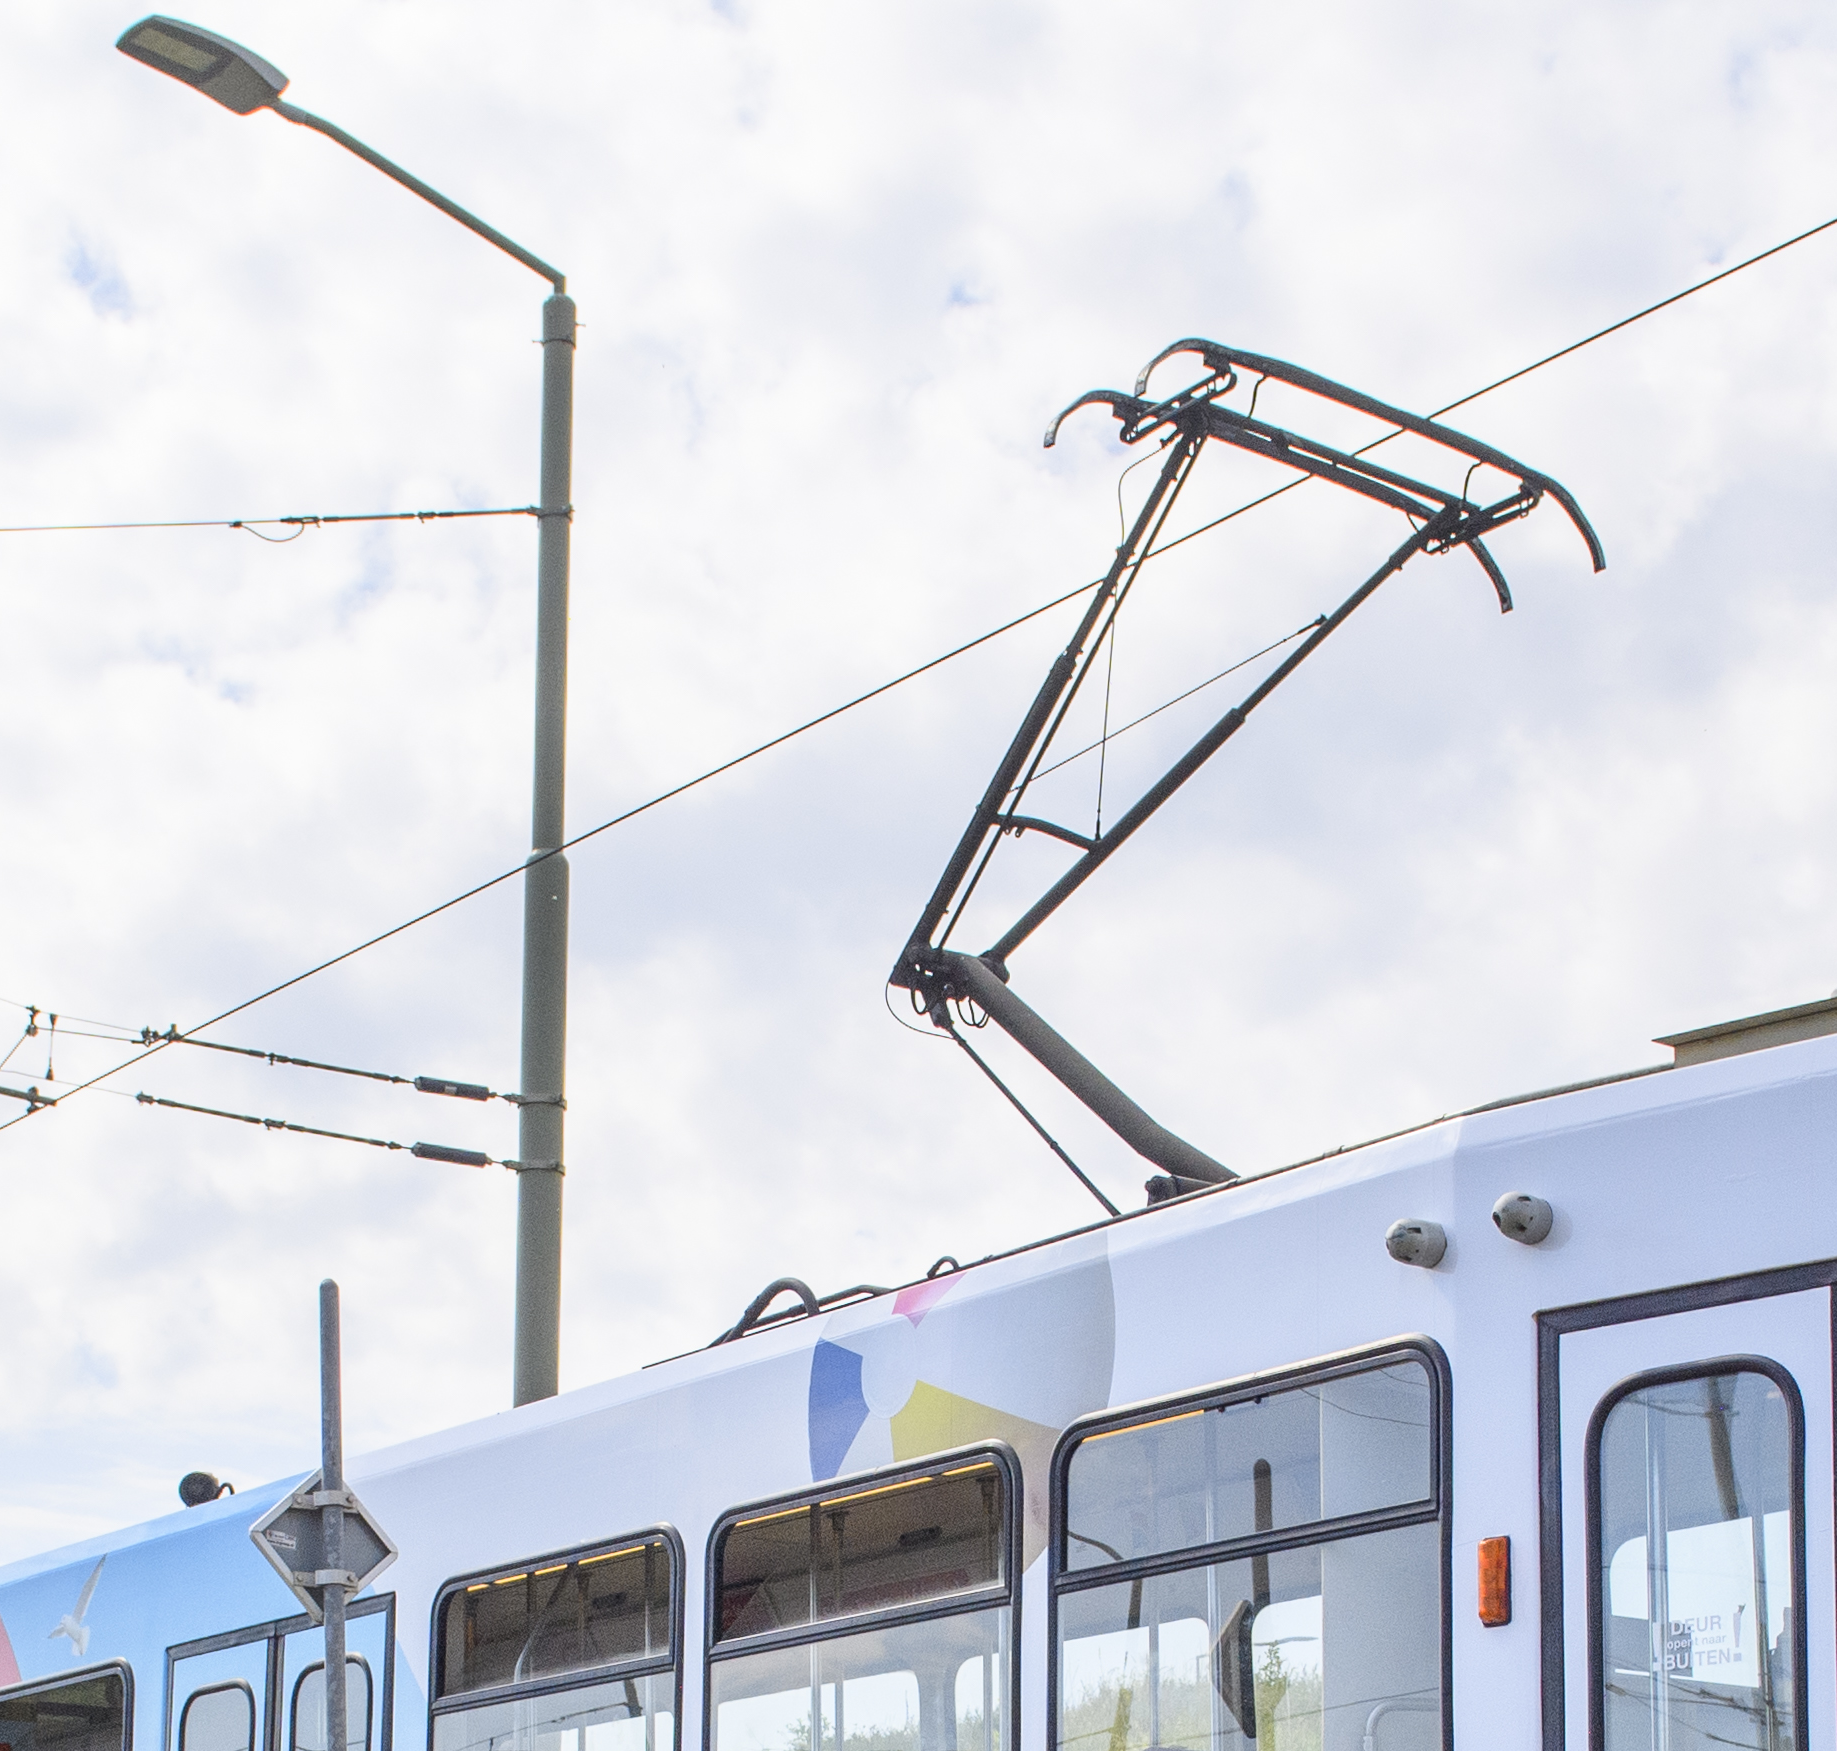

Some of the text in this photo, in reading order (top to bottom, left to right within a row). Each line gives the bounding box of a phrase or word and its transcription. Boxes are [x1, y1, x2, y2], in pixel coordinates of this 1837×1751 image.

[1670, 1614, 1722, 1636] DEUR
[1666, 1634, 1728, 1651] opent naar
